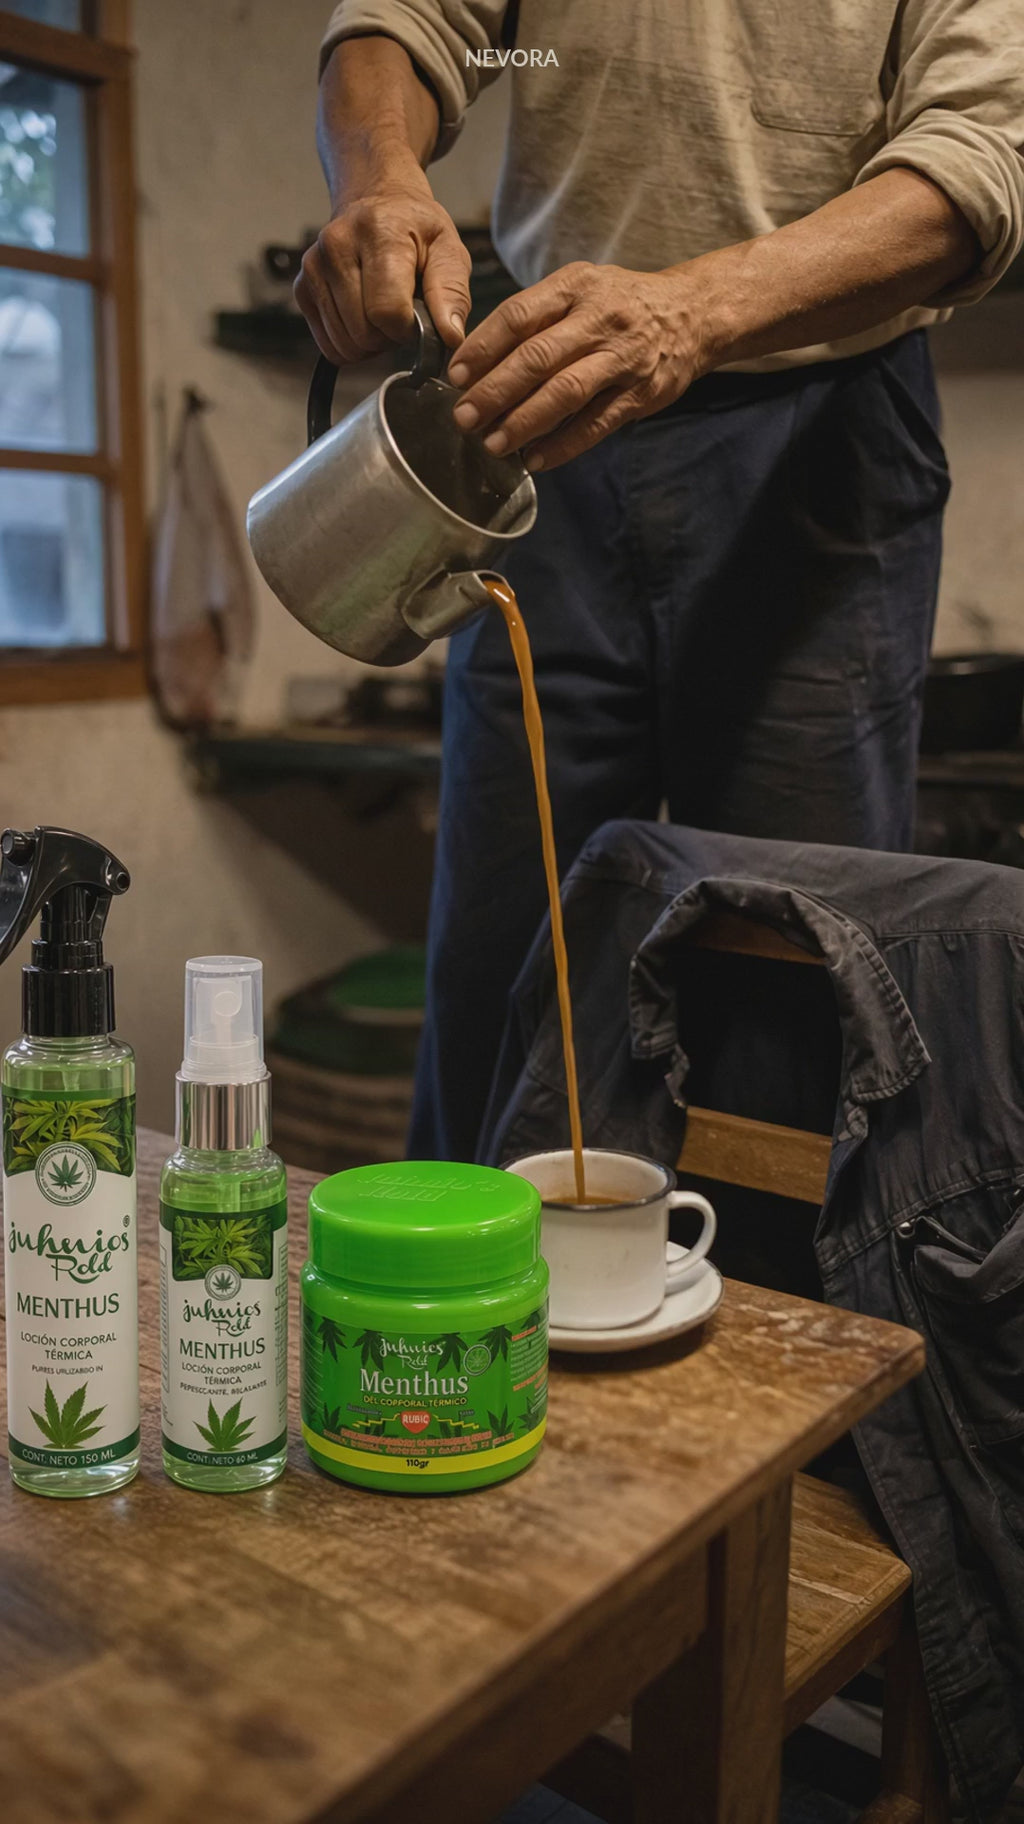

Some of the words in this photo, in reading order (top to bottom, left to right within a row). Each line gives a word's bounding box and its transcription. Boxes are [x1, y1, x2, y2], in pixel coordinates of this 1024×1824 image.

[17, 1292, 120, 1319] MENTHUS
[20, 1331, 57, 1347] LOCIÓN
[60, 1332, 117, 1347] CORPORAL
[45, 1349, 93, 1361] TÉRMICA
[180, 1337, 266, 1360] MENTHUS
[181, 1362, 214, 1375] LOCIÓN
[216, 1361, 262, 1375] CORPORAL
[360, 1368, 469, 1396] Menthus
[49, 1455, 78, 1466] NETO
[80, 1453, 99, 1464] 150
[100, 1448, 116, 1460] ML
[212, 1455, 235, 1465] NETO
[406, 1459, 430, 1469] 110gr
